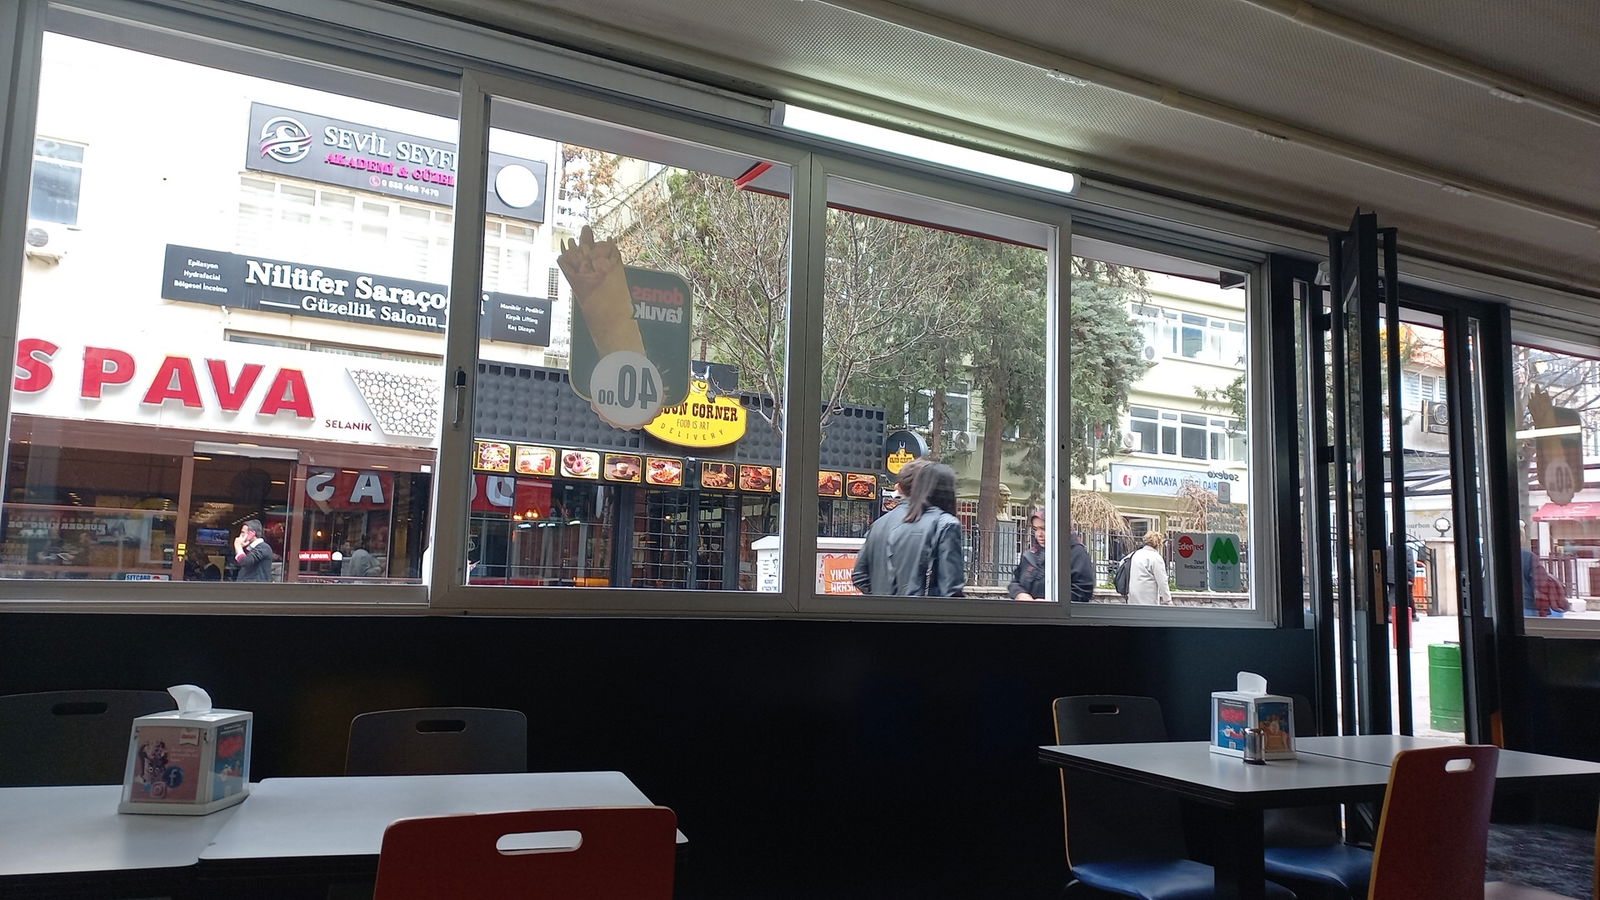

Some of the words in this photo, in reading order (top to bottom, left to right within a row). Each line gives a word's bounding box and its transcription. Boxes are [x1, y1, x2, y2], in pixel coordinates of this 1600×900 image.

[324, 126, 391, 158] SEVİL
[188, 259, 218, 269] Epilasyon
[184, 270, 220, 280] Hydrafacial
[245, 260, 349, 296] Nilüfer
[174, 280, 201, 289] Bölgesel
[302, 296, 376, 319] Güzellik
[380, 306, 437, 327] Salonu
[692, 403, 738, 422] CORNER
[325, 418, 372, 432] SELANİK
[676, 418, 690, 429] FOOD
[692, 420, 697, 429] IS
[699, 421, 710, 430] ART
[660, 423, 724, 441] DELIVERY
[1142, 475, 1177, 487] ÇANKAYA
[830, 568, 854, 581] YIKIN
